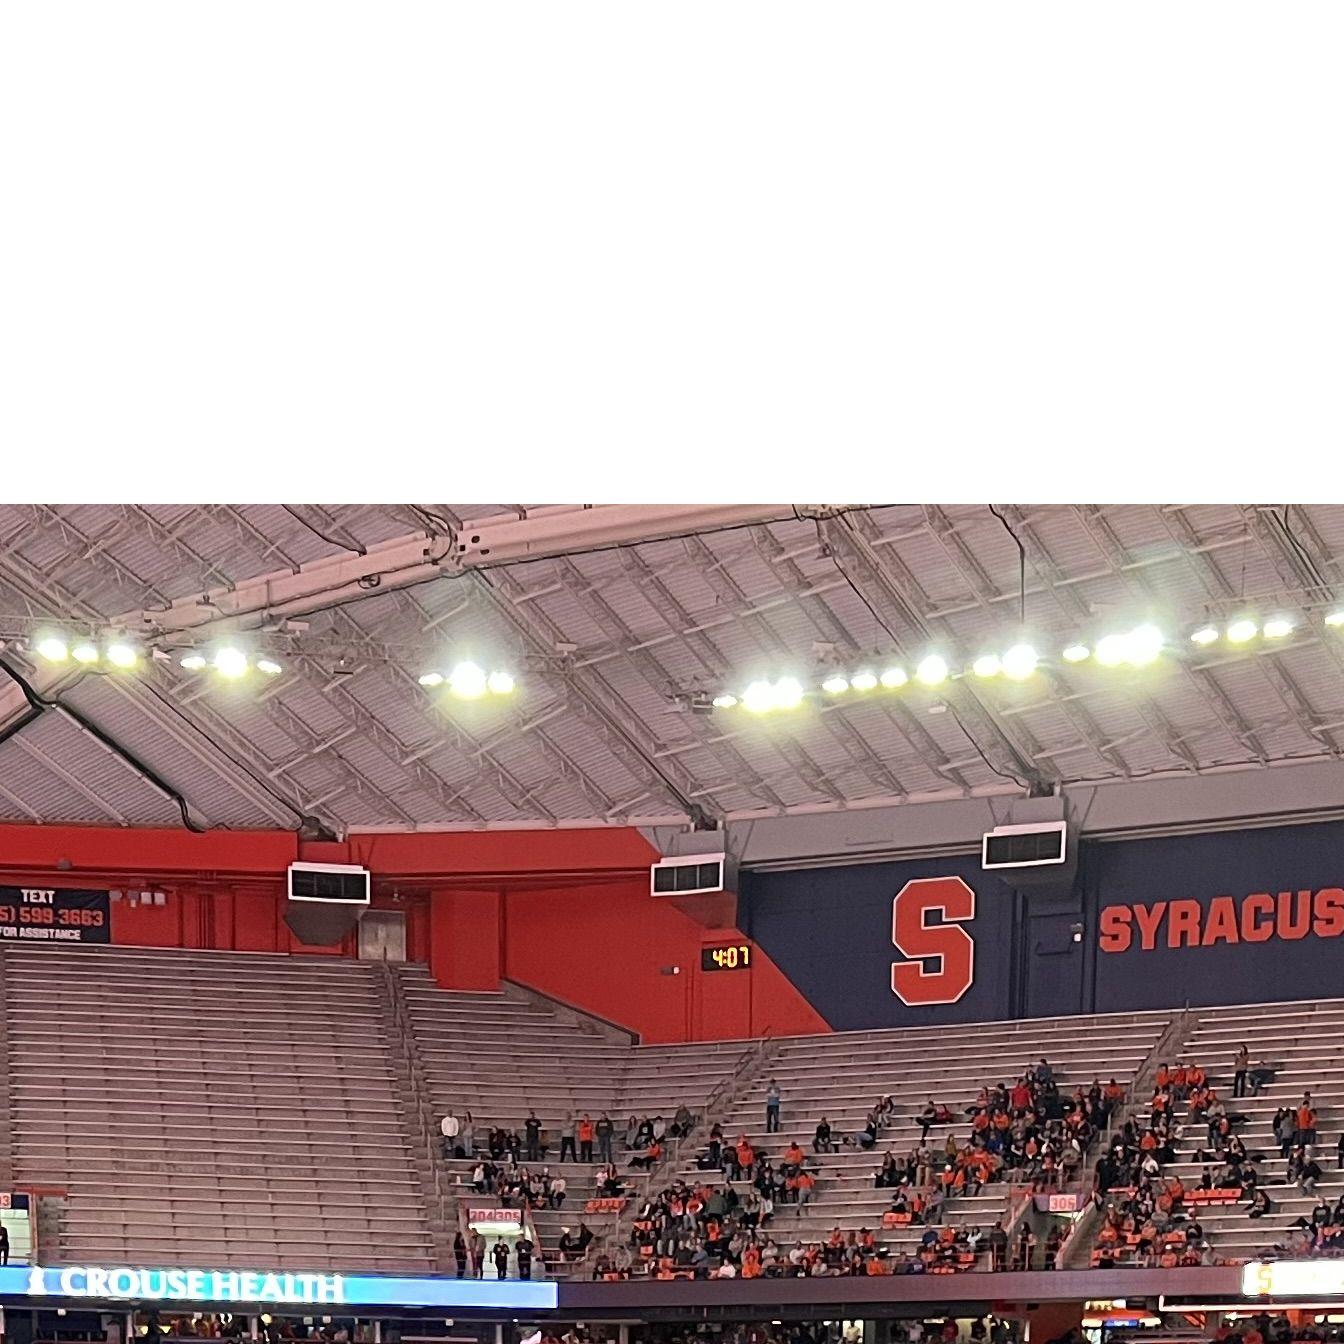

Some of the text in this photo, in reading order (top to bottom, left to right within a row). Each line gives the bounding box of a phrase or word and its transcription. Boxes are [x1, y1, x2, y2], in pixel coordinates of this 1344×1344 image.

[21, 889, 56, 904] TEXT
[19, 927, 81, 940] ASSISTANCE
[891, 875, 975, 1006] S
[712, 946, 749, 968] 4:07
[60, 1267, 344, 1303] CROUSE HEALTH
